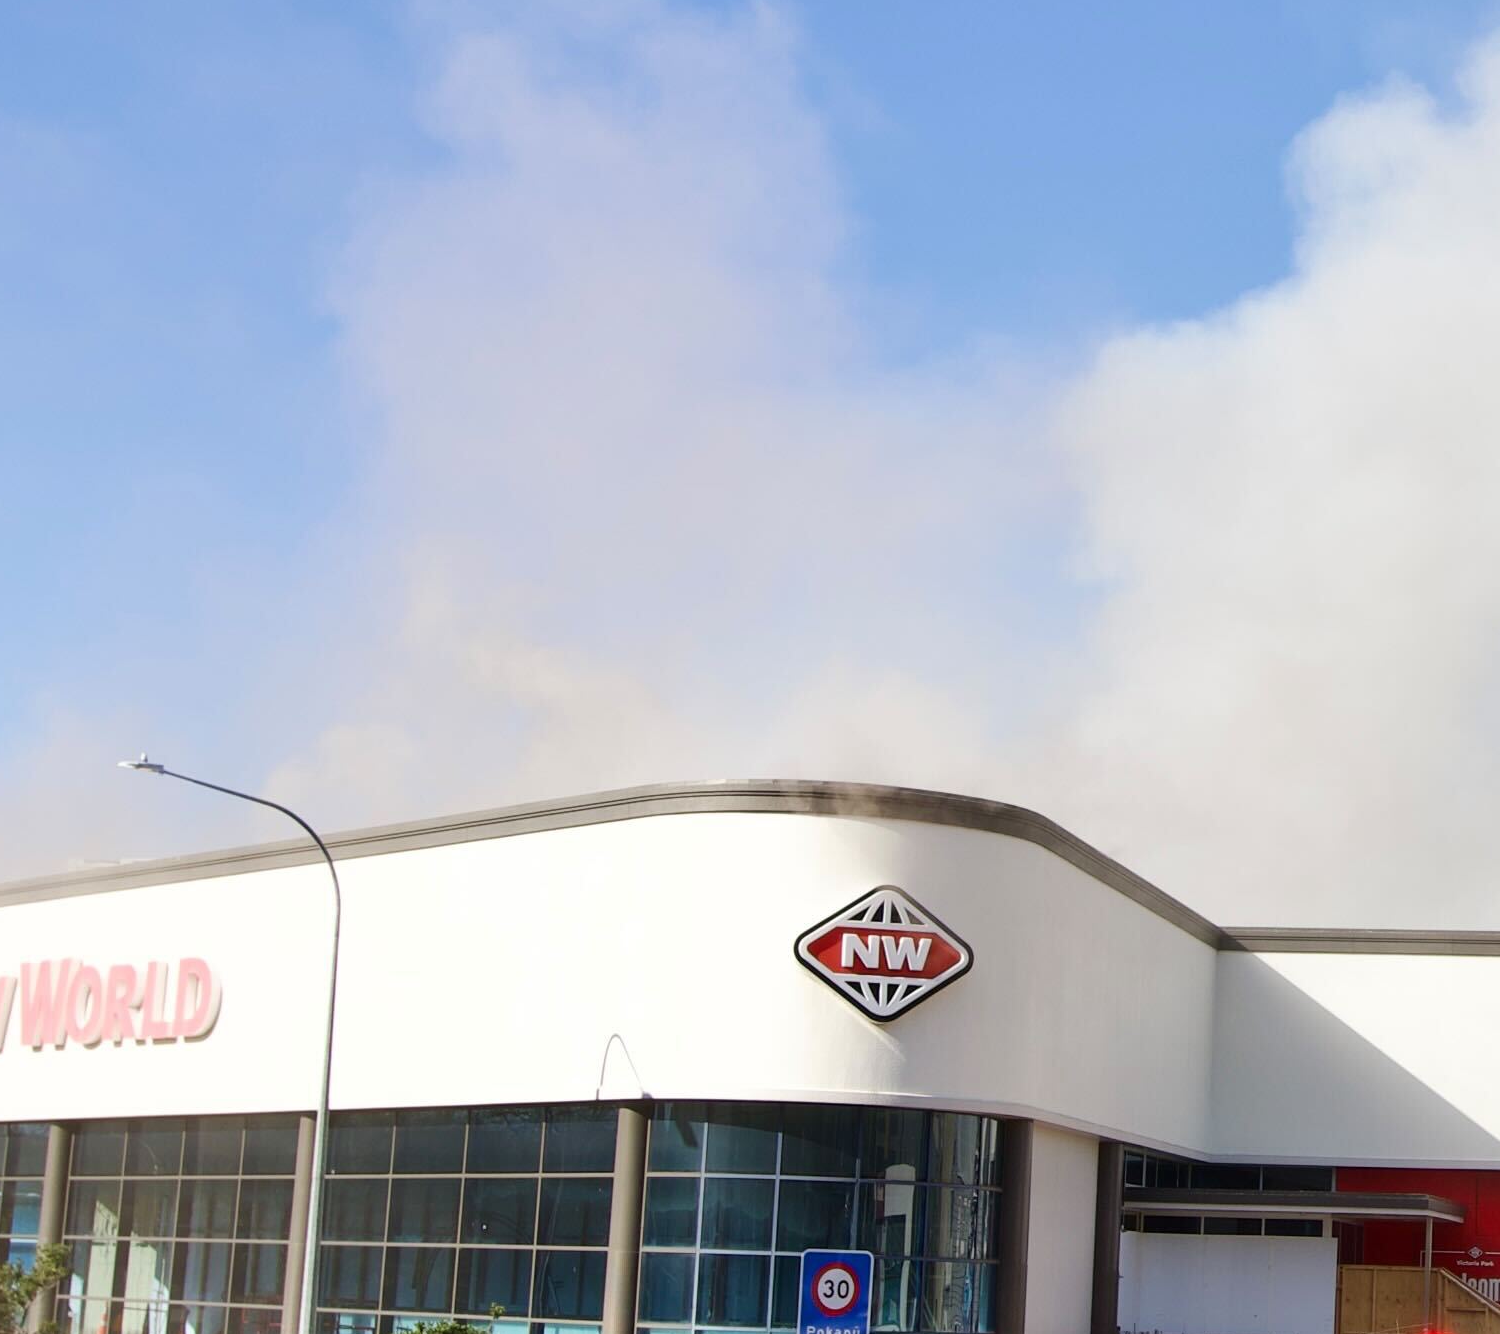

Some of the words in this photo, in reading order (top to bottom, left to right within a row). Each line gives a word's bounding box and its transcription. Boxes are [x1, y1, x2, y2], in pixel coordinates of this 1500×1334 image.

[841, 933, 932, 971] NW
[20, 958, 223, 1053] WORLD
[1480, 1259, 1495, 1267] Park
[822, 1279, 850, 1299] 30
